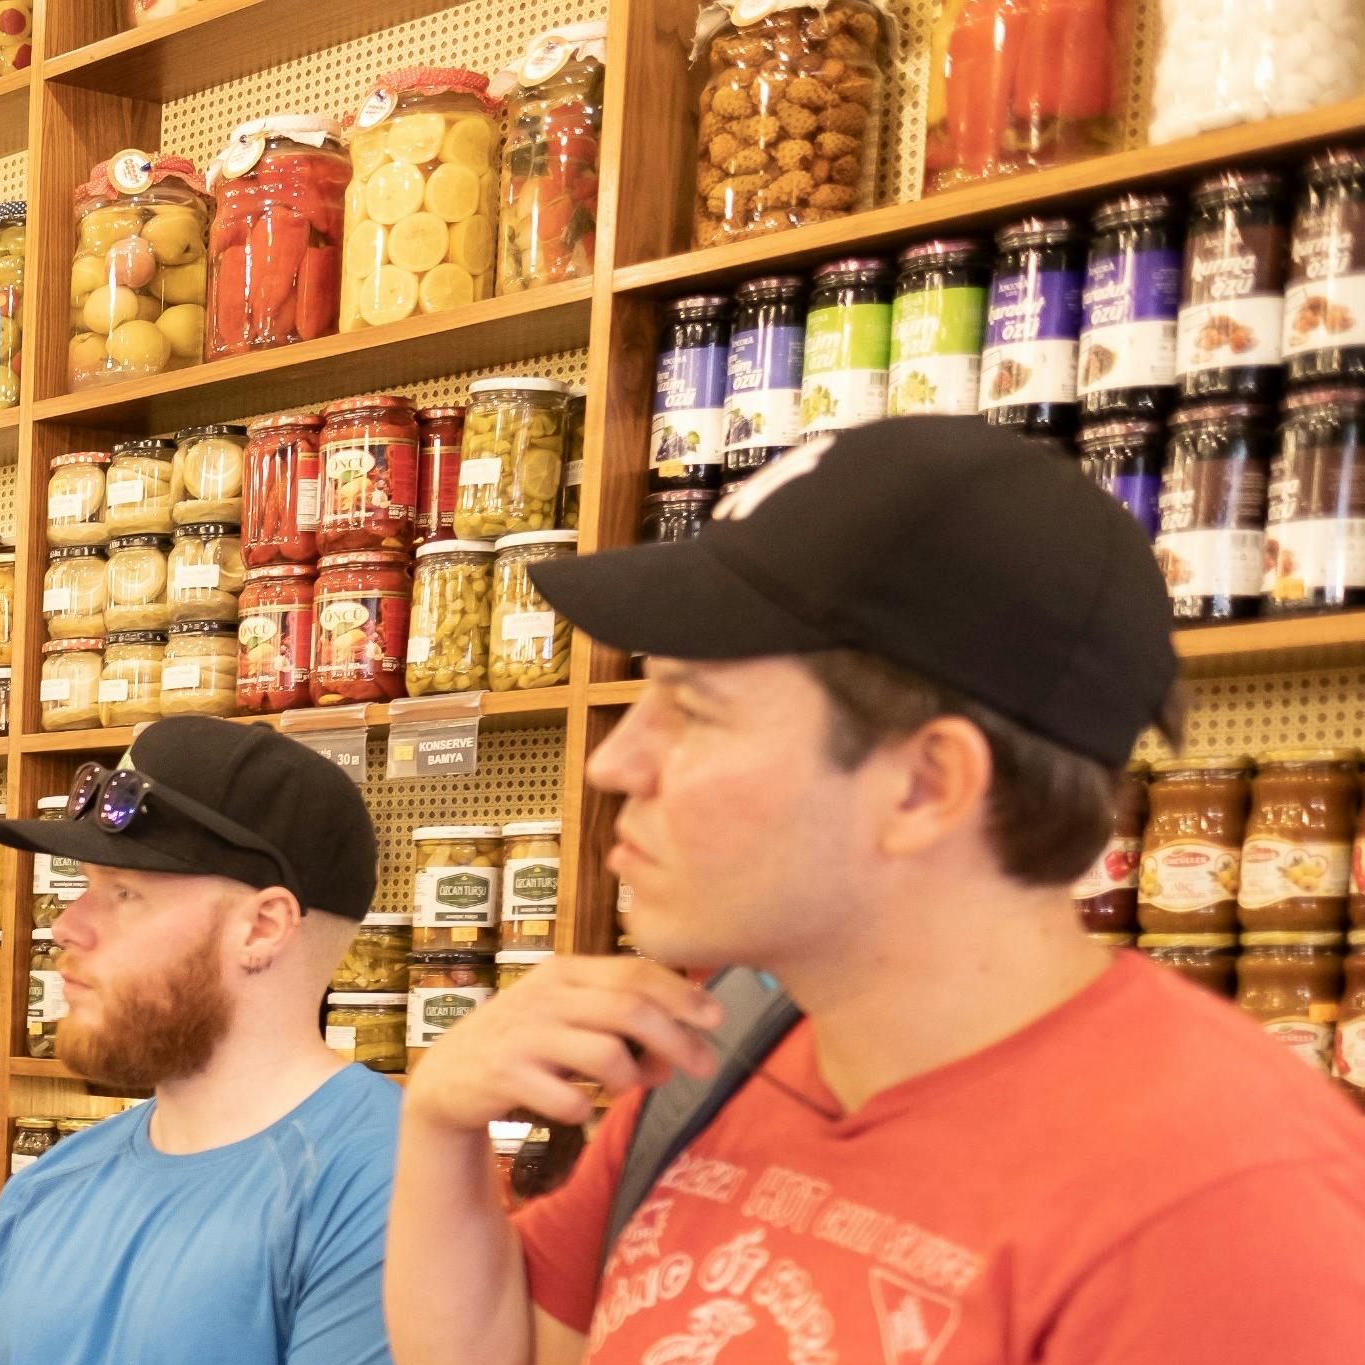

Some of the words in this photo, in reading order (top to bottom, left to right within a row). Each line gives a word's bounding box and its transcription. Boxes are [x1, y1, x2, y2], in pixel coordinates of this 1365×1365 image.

[419, 736, 475, 752] KONSERVE
[427, 752, 464, 766] BAMYA
[536, 876, 558, 890] TURŞ
